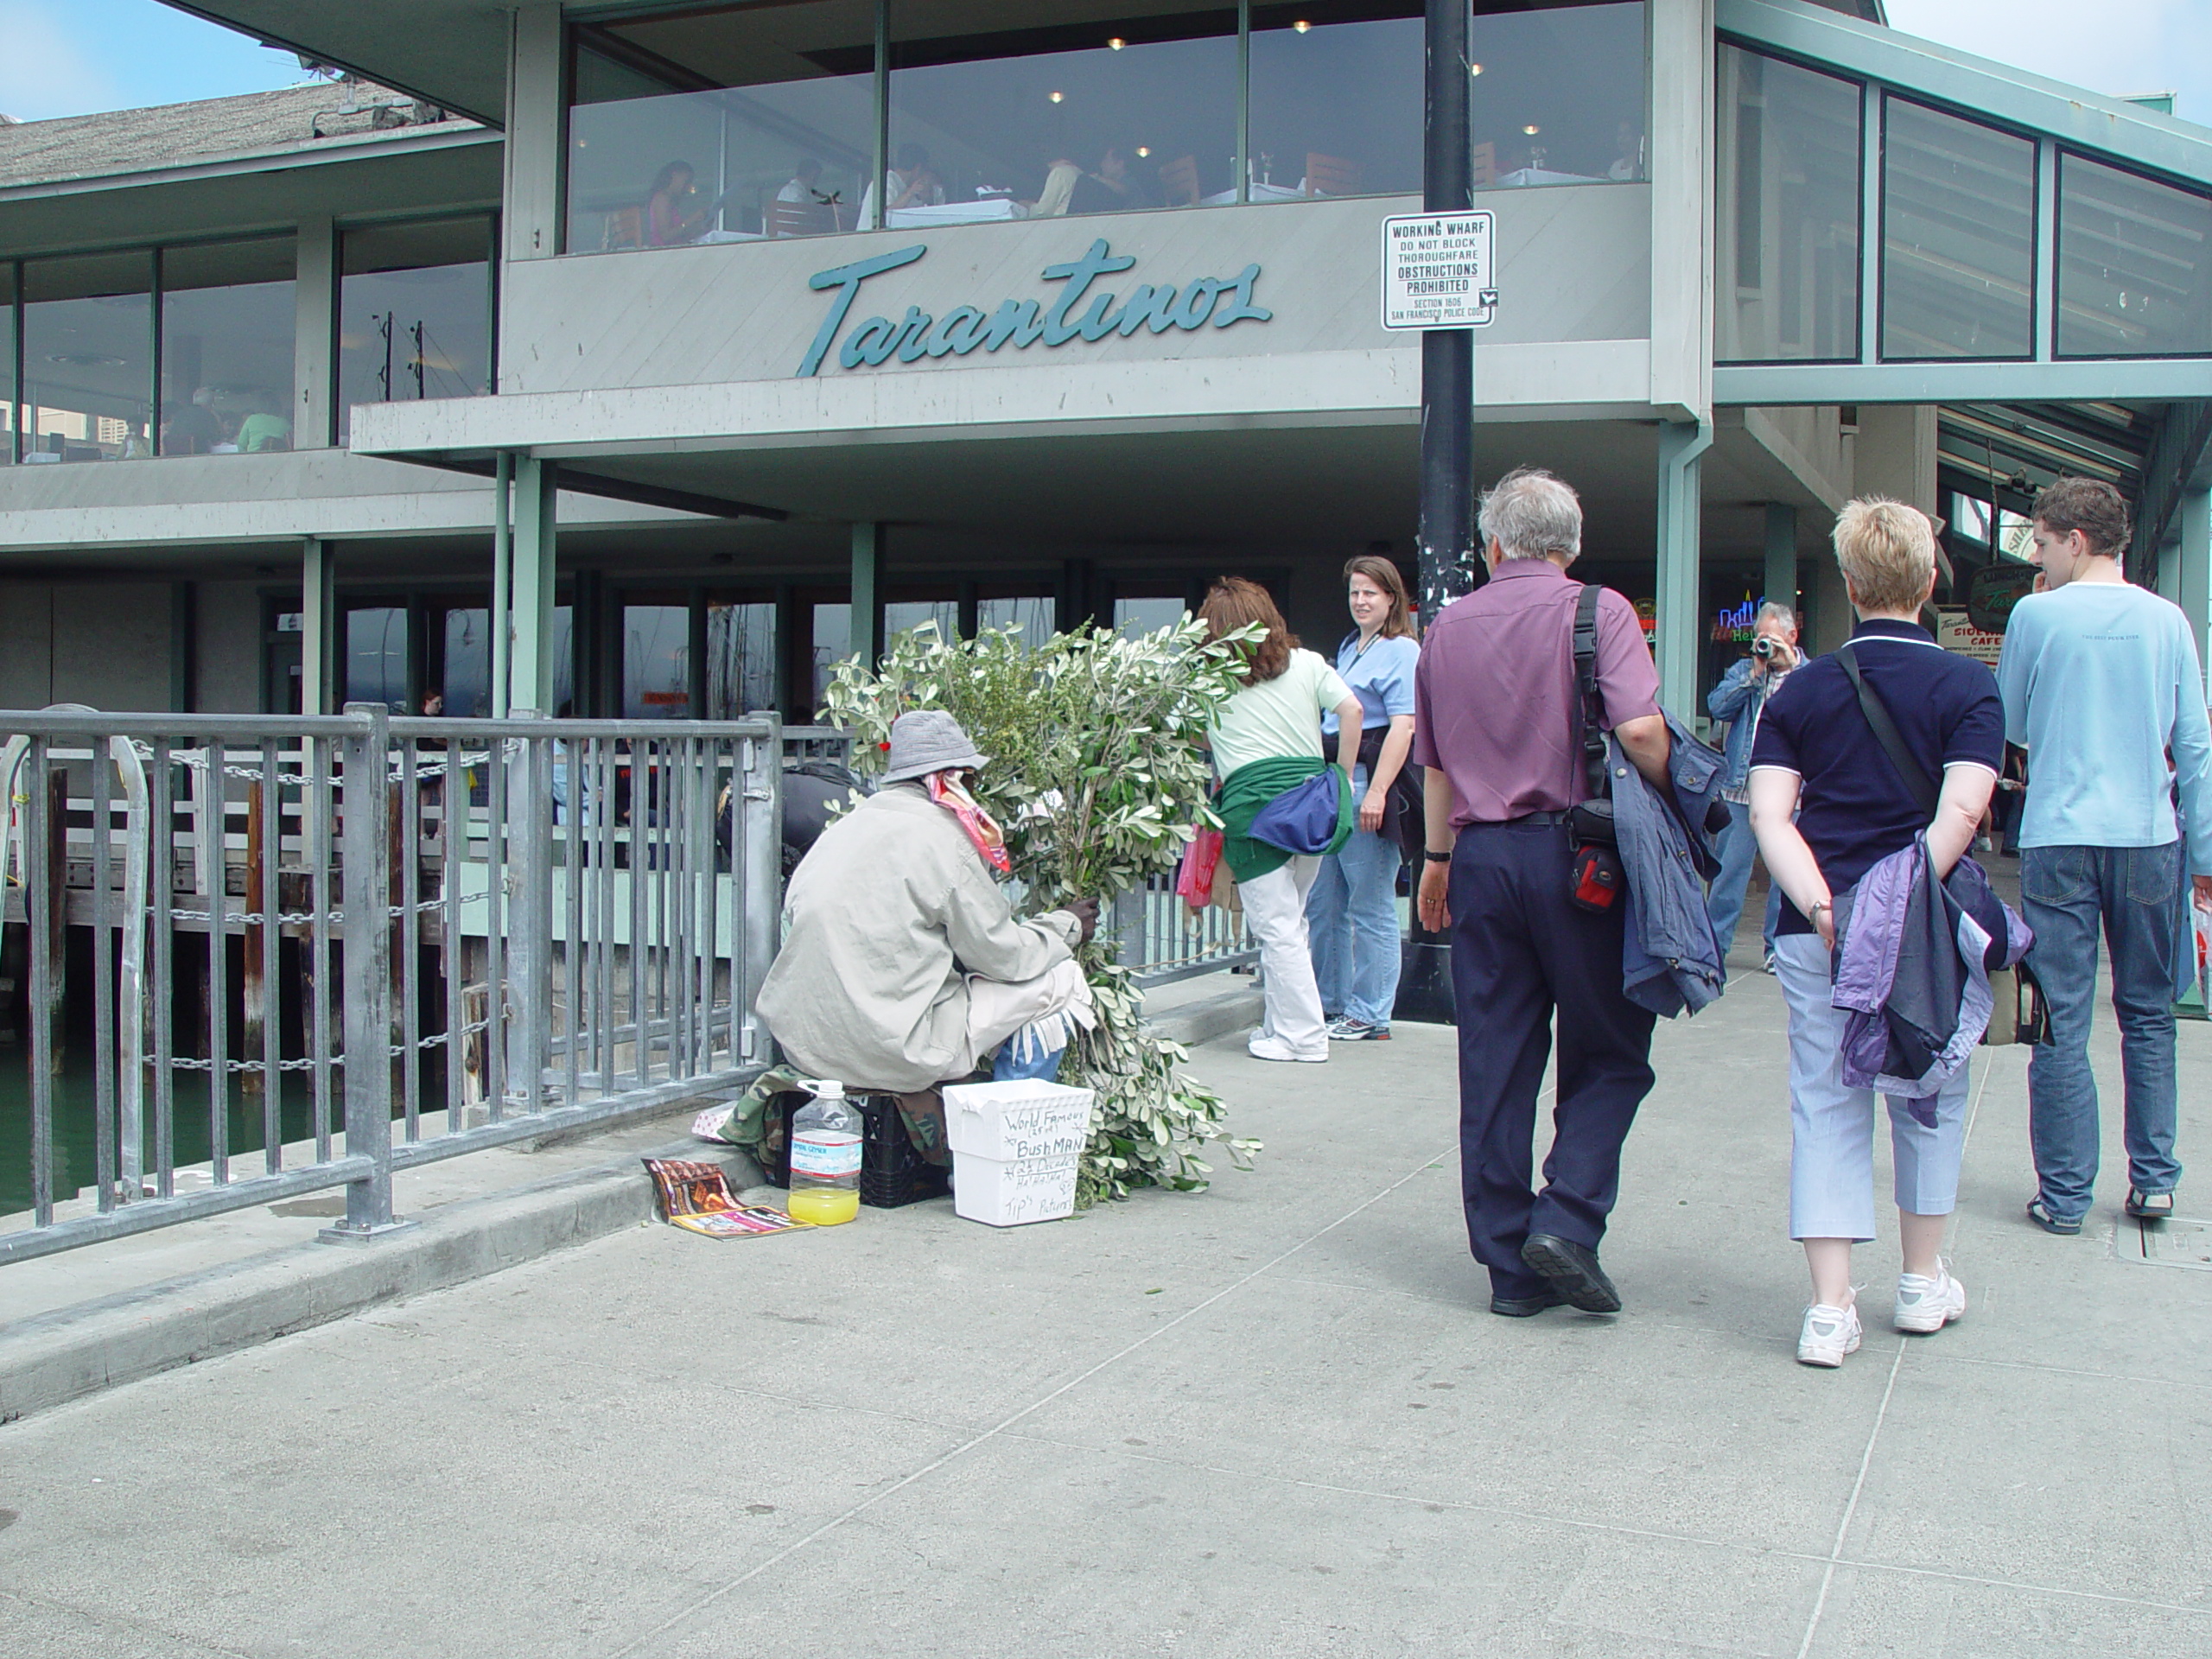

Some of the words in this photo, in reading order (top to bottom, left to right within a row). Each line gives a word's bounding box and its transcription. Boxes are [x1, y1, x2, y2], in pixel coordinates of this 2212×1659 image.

[1393, 225, 1441, 238] WORKING
[1447, 222, 1484, 235] WHARF
[1401, 241, 1414, 251] DO
[1419, 240, 1438, 250] NOT
[1443, 238, 1476, 248] BLOCK
[1398, 250, 1478, 263] THOROUGHFARE
[1398, 264, 1478, 278] OBSTRUCTIONS
[1408, 280, 1468, 294] PROHIBITED
[796, 238, 1272, 378] Tarantinos
[1414, 299, 1442, 308] SECTION
[1392, 310, 1404, 320] SAN
[1407, 308, 1441, 319] FRANCISCO
[1444, 308, 1465, 317] POLICE
[1467, 307, 1484, 316] CODE
[1005, 1110, 1040, 1131] World
[1044, 1110, 1084, 1126] Famous
